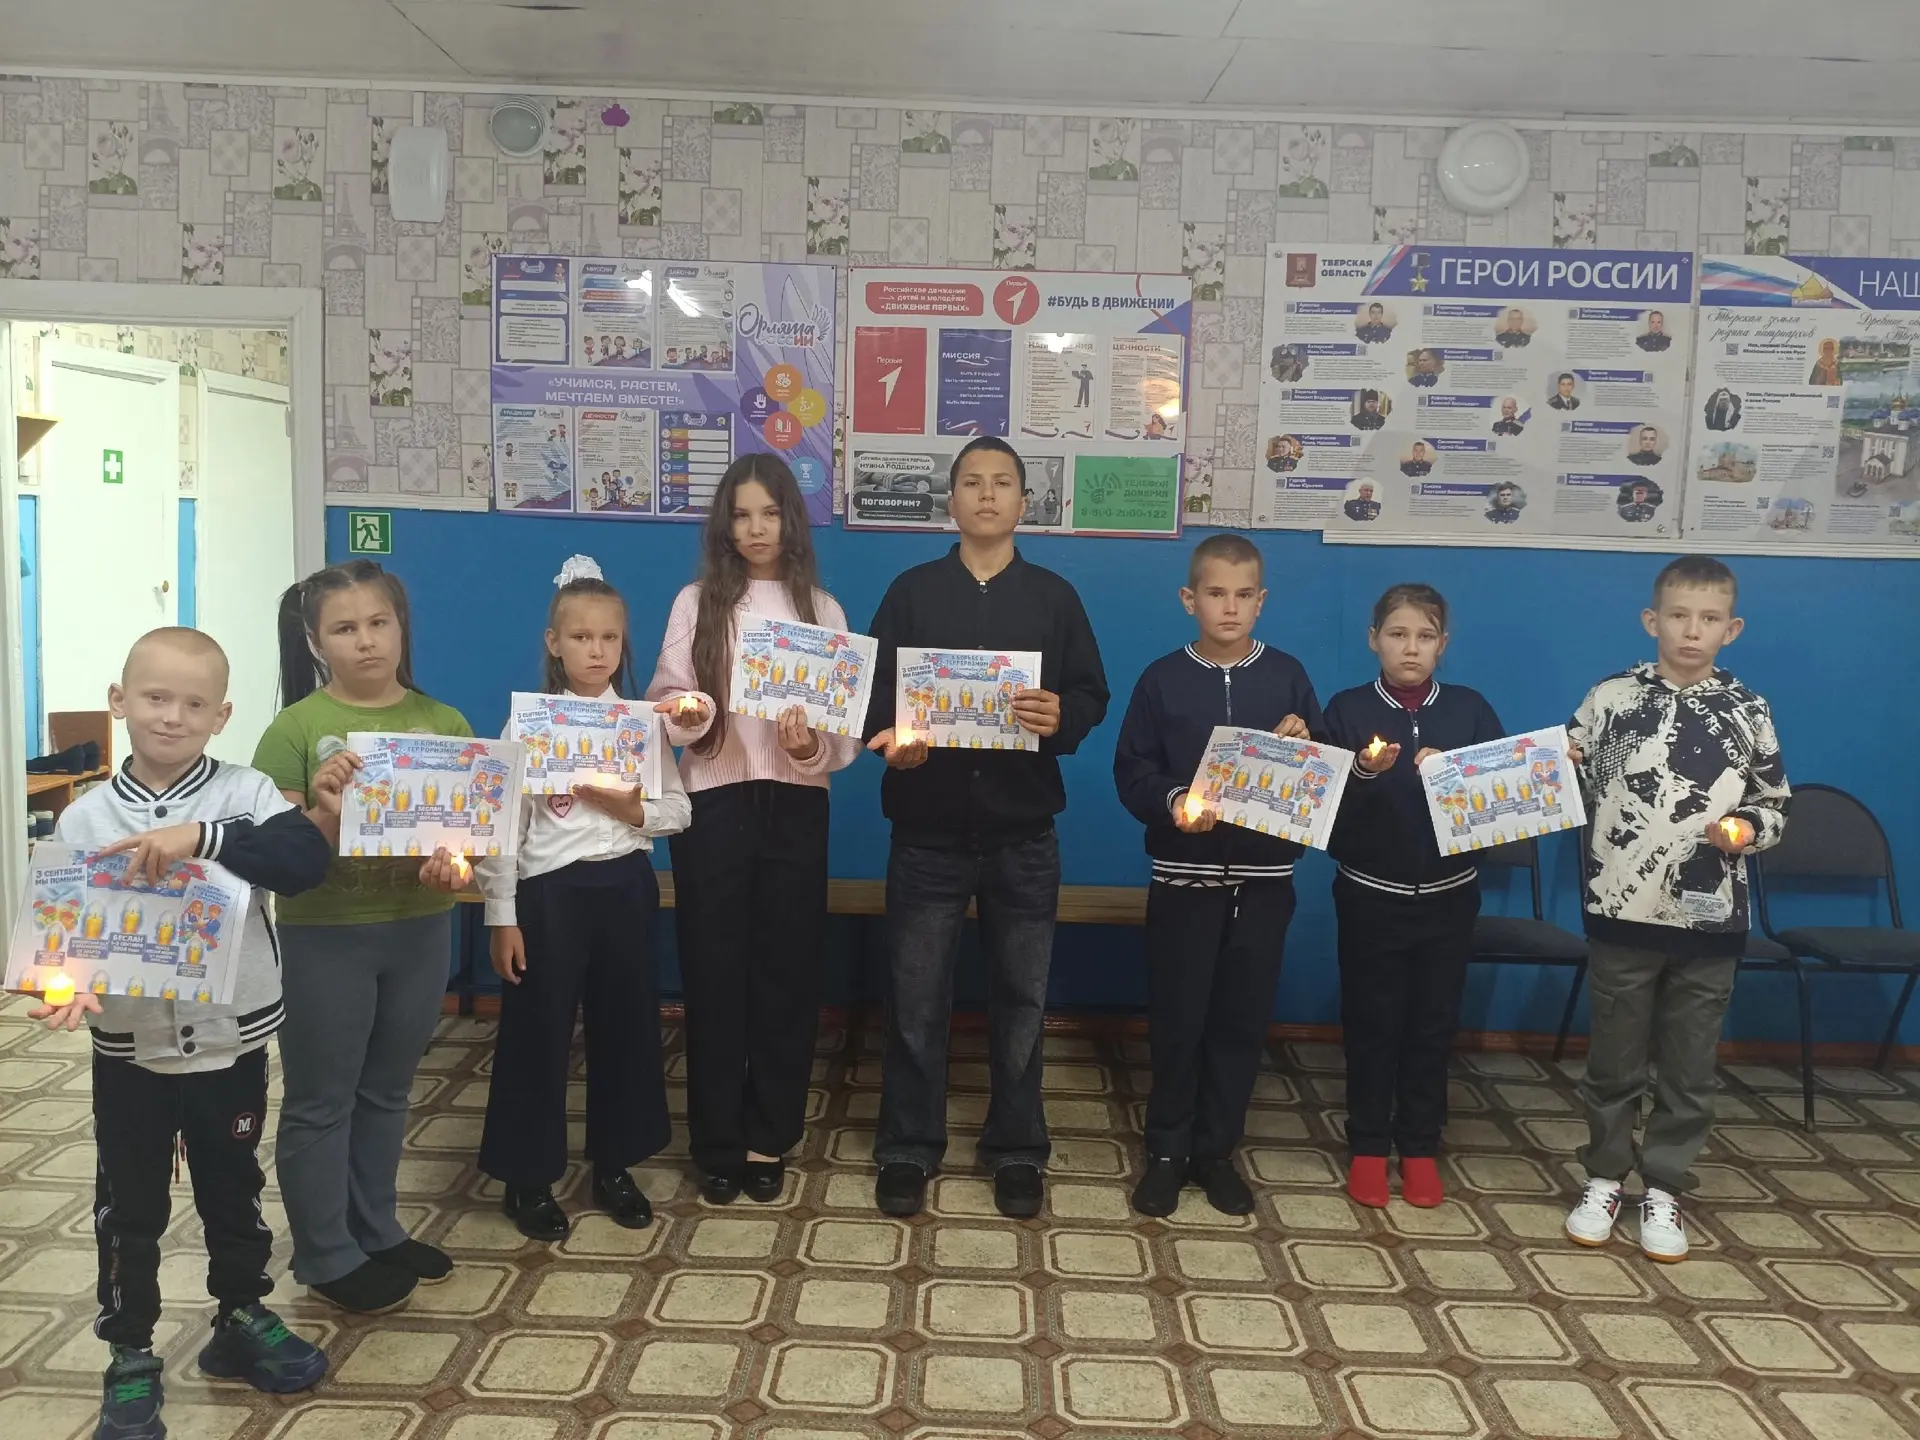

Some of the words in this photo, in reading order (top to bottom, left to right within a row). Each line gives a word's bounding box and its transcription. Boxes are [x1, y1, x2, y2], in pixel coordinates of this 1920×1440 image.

[1321, 259, 1373, 267] ТВЕРСКАЯ
[1321, 269, 1367, 278] ОБЛАСТЬ
[1440, 258, 1539, 287] ГЕРОИ
[1547, 260, 1678, 291] РОССИИ
[883, 285, 927, 293] Российское
[932, 304, 969, 312] ПЕРВЫХ»
[1047, 296, 1089, 309] #БУДЬ
[1092, 297, 1100, 307] В
[1102, 297, 1175, 310] ДВИЖЕНИИ
[739, 303, 816, 339] Орлята
[1113, 344, 1161, 352] ЦЕННОСТИ
[942, 352, 981, 360] МИССИЯ
[548, 377, 617, 391] «УЧИМСЯ,
[620, 380, 682, 393] РАСТЕМ,
[545, 392, 614, 404] МЕЧТАЕМ
[618, 394, 685, 406] ВМЕСТЕ!»
[886, 463, 931, 471] ПОДДЕРЖКА
[861, 497, 921, 507] ПОГОВОРИМ?
[35, 870, 43, 878] 3
[43, 867, 83, 877] СЕНТЯБРЯ
[49, 875, 86, 885] ПОМНИМ!
[113, 934, 144, 944] БЕСЛАН
[237, 1117, 252, 1133] M
